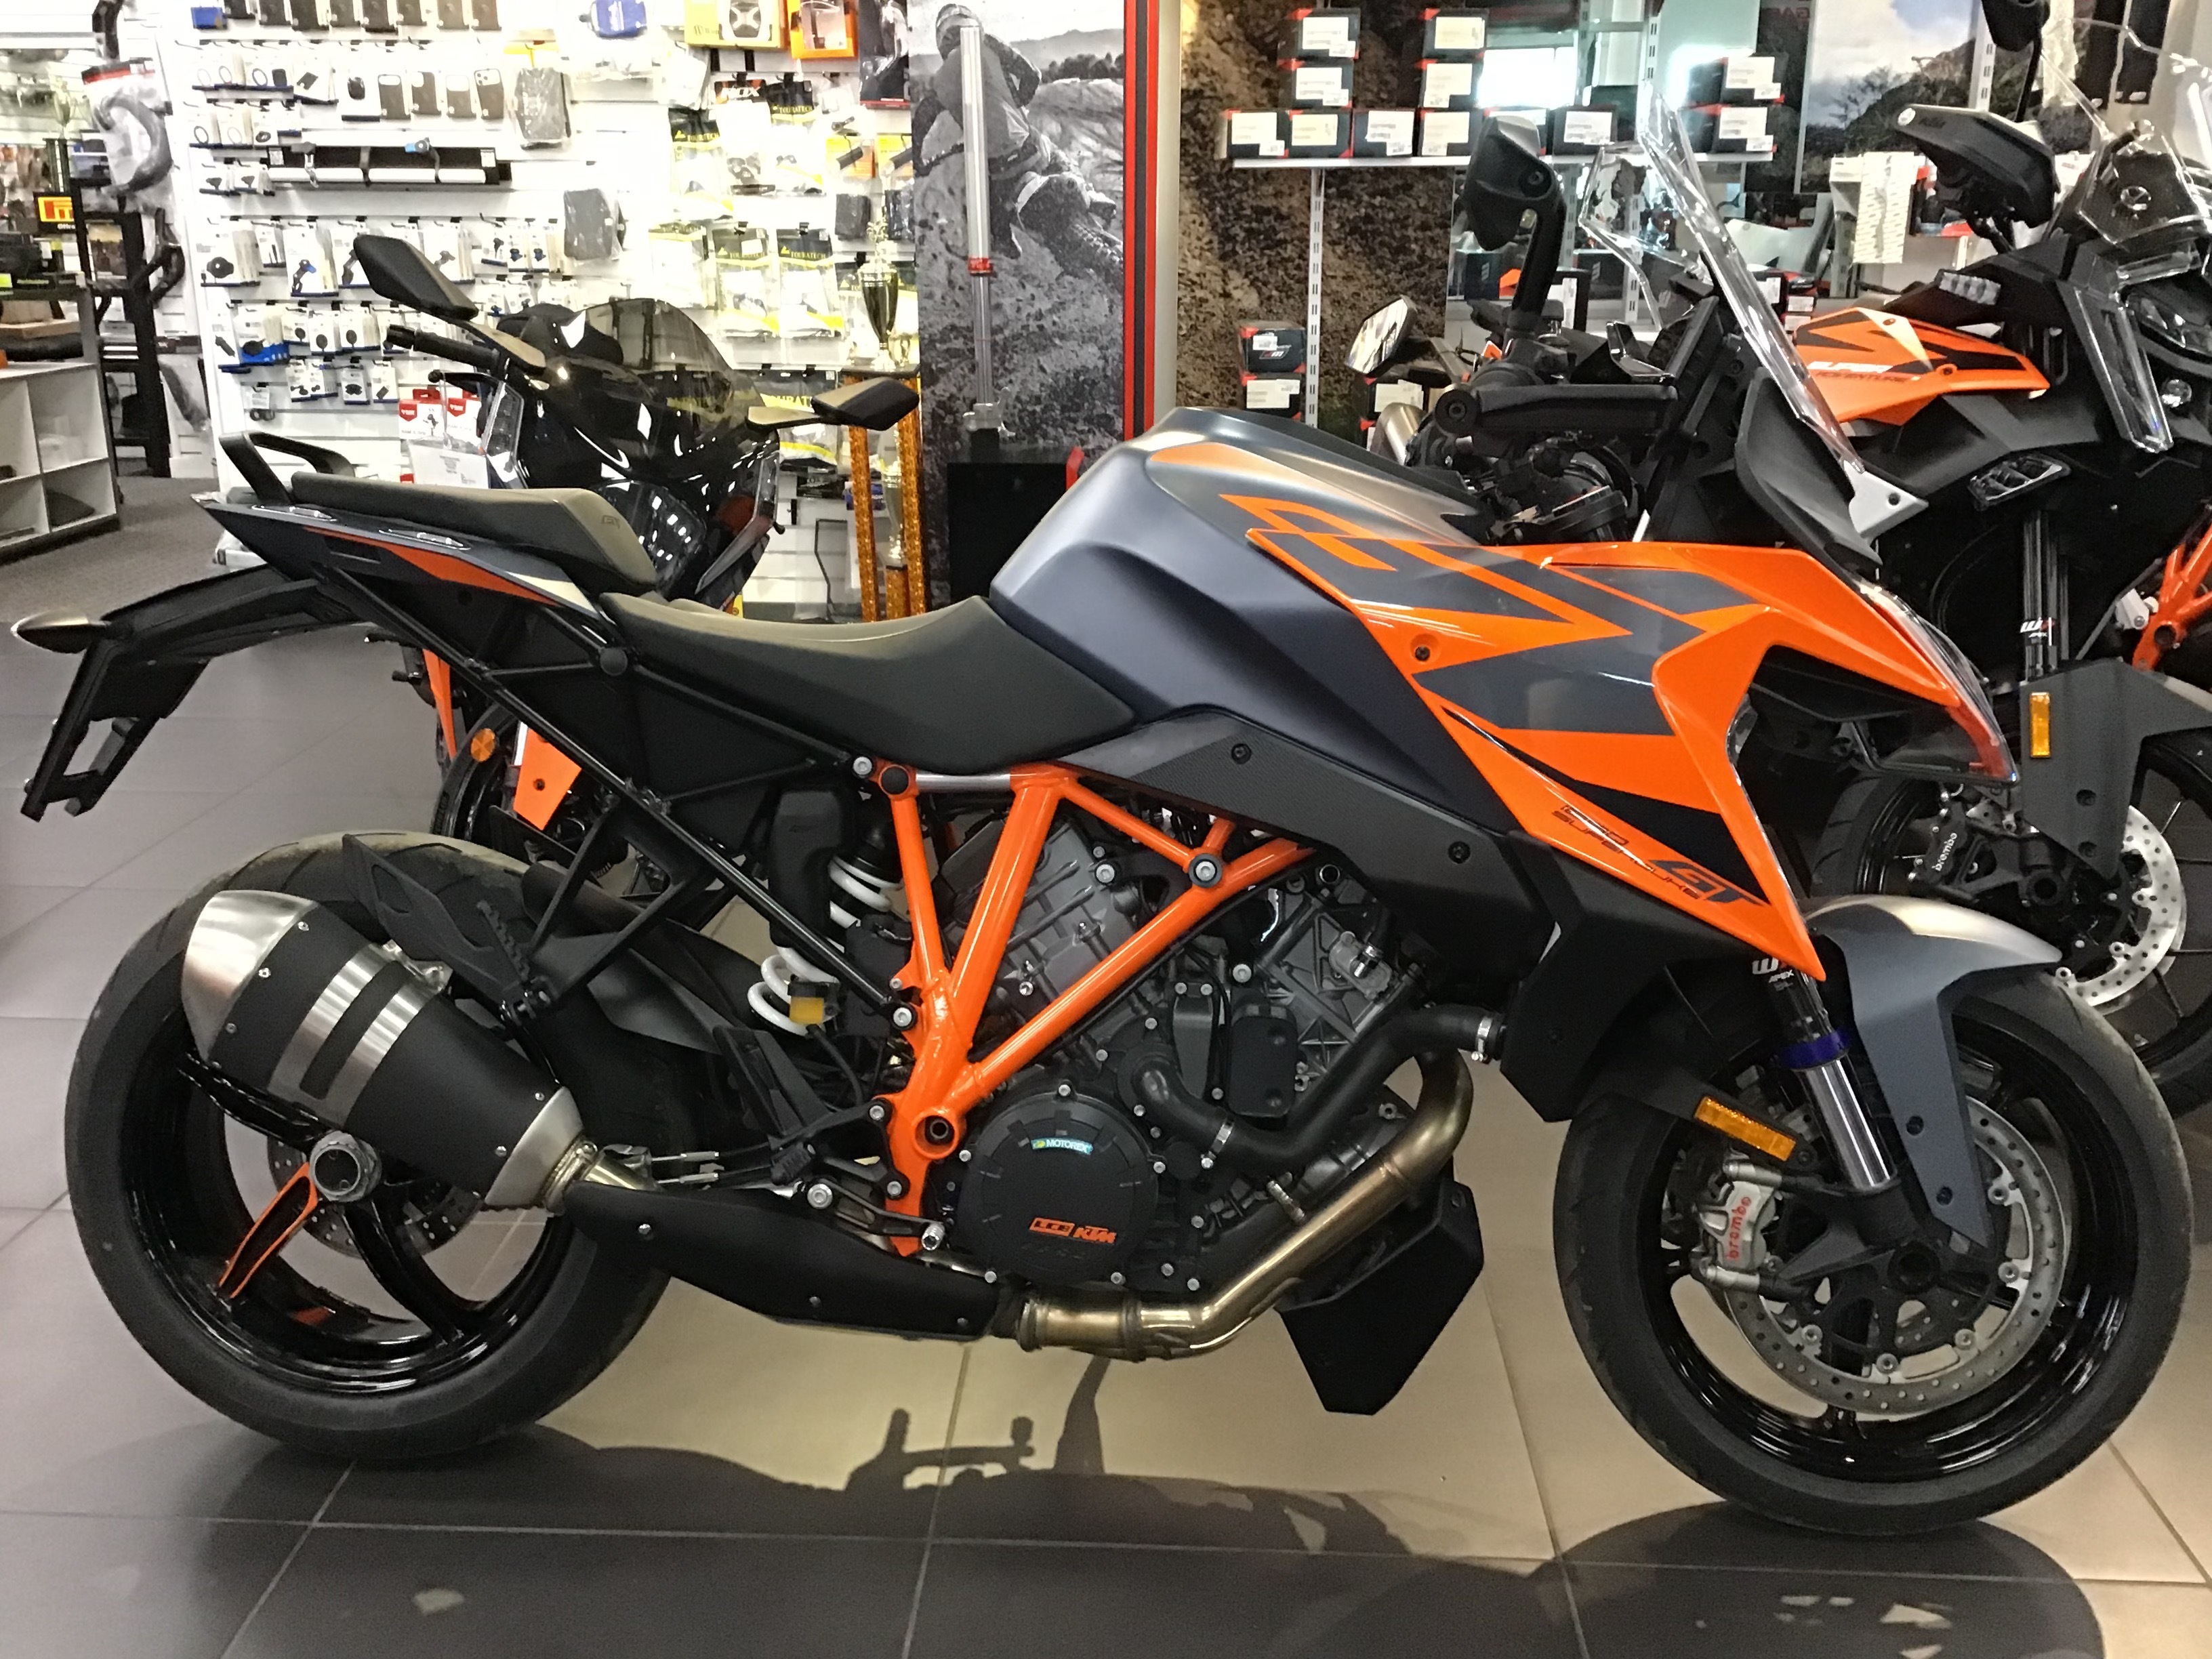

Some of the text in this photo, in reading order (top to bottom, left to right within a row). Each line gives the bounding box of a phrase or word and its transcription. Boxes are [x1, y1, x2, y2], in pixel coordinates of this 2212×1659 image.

[1931, 832, 1958, 872] brembo
[1647, 859, 1767, 907] GT
[1752, 956, 1788, 975] W
[1046, 1139, 1092, 1154] MOTOREX
[1073, 1225, 1117, 1244] KTM
[1725, 1196, 1752, 1260] brembo
